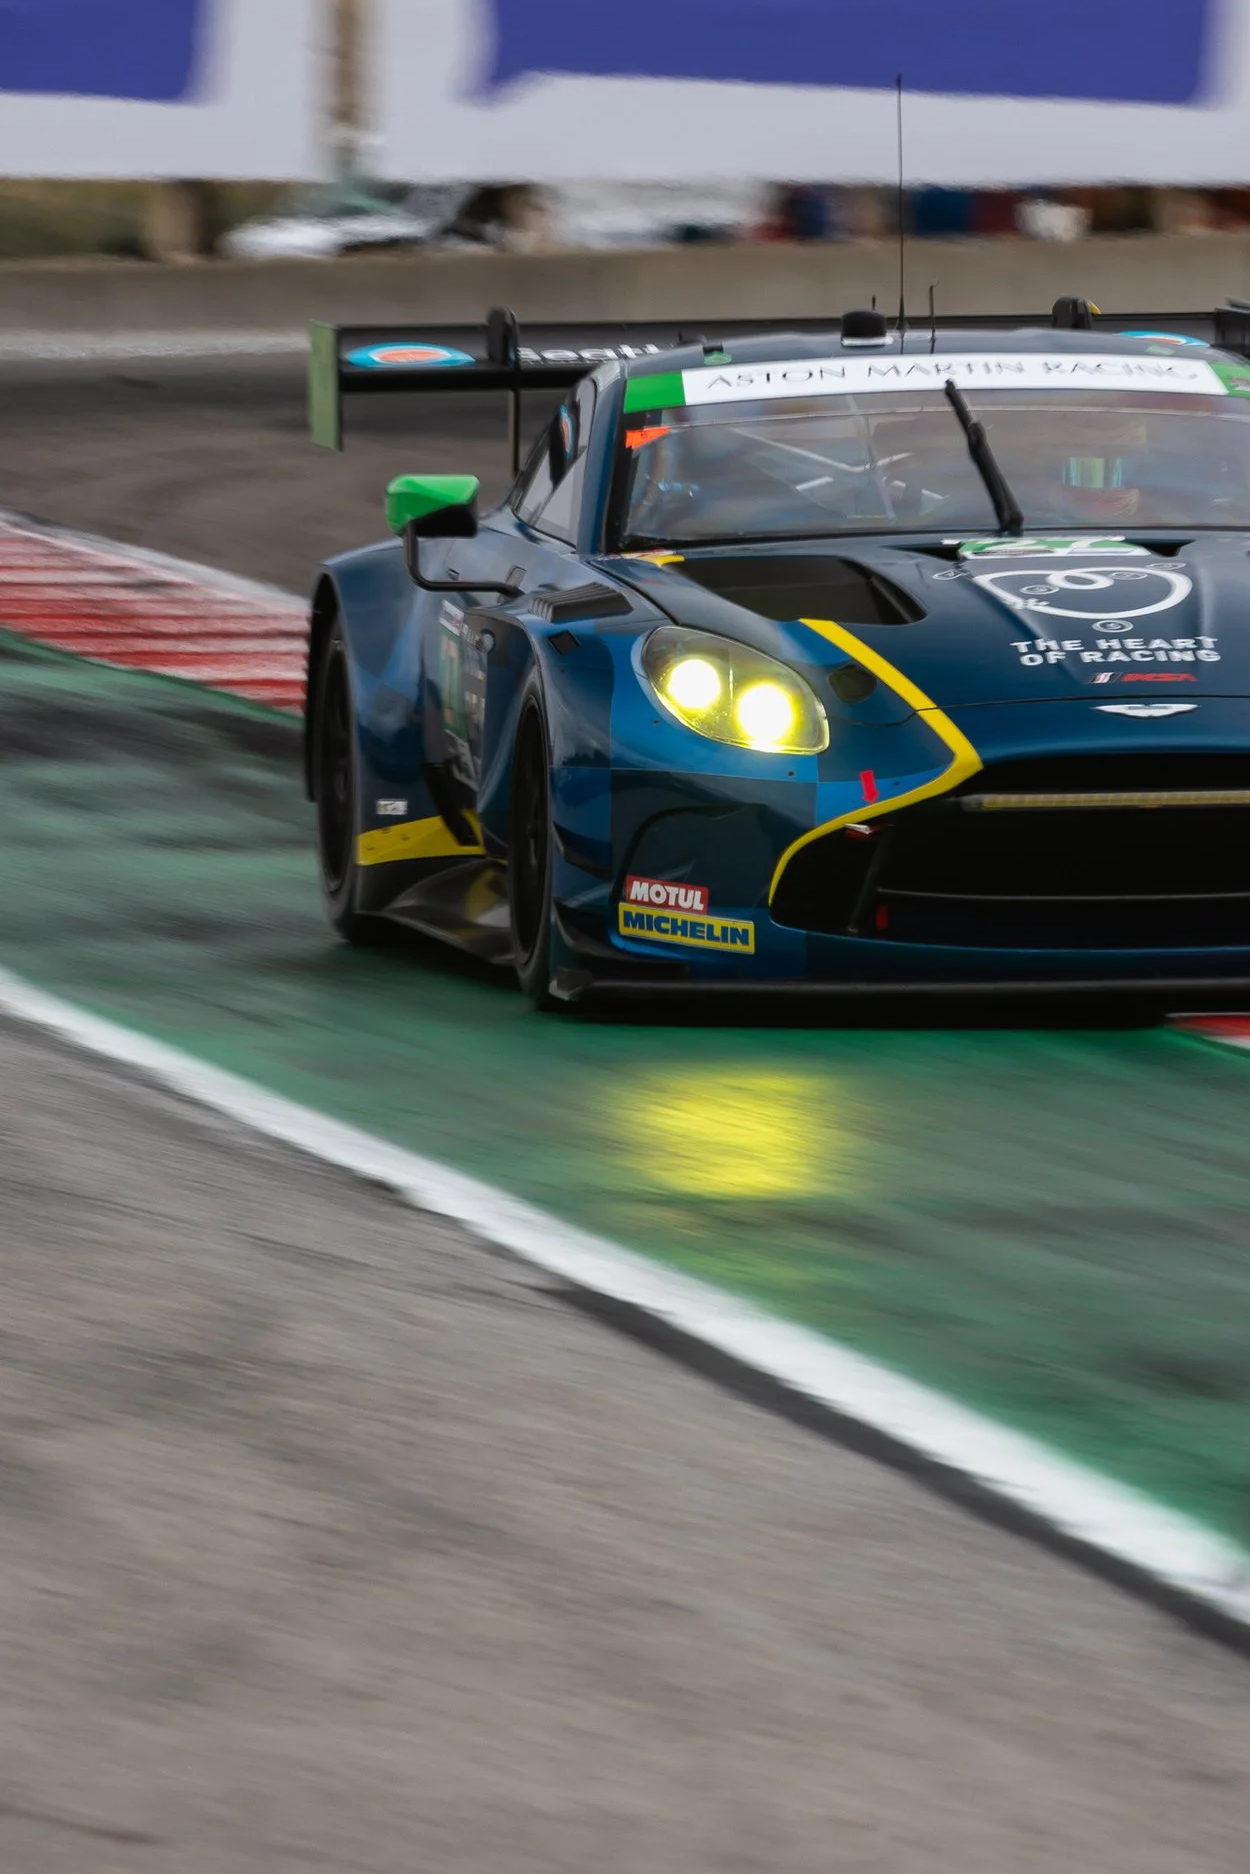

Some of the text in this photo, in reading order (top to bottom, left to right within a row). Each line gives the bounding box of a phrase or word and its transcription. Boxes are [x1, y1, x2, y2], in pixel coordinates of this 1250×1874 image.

[708, 366, 845, 389] ASTON
[868, 361, 1025, 377] MARTIN
[1010, 636, 1218, 653] THE HEART
[1019, 650, 1222, 666] OF RACING
[629, 881, 705, 911] MOTUL
[623, 910, 750, 946] MICHELIN
